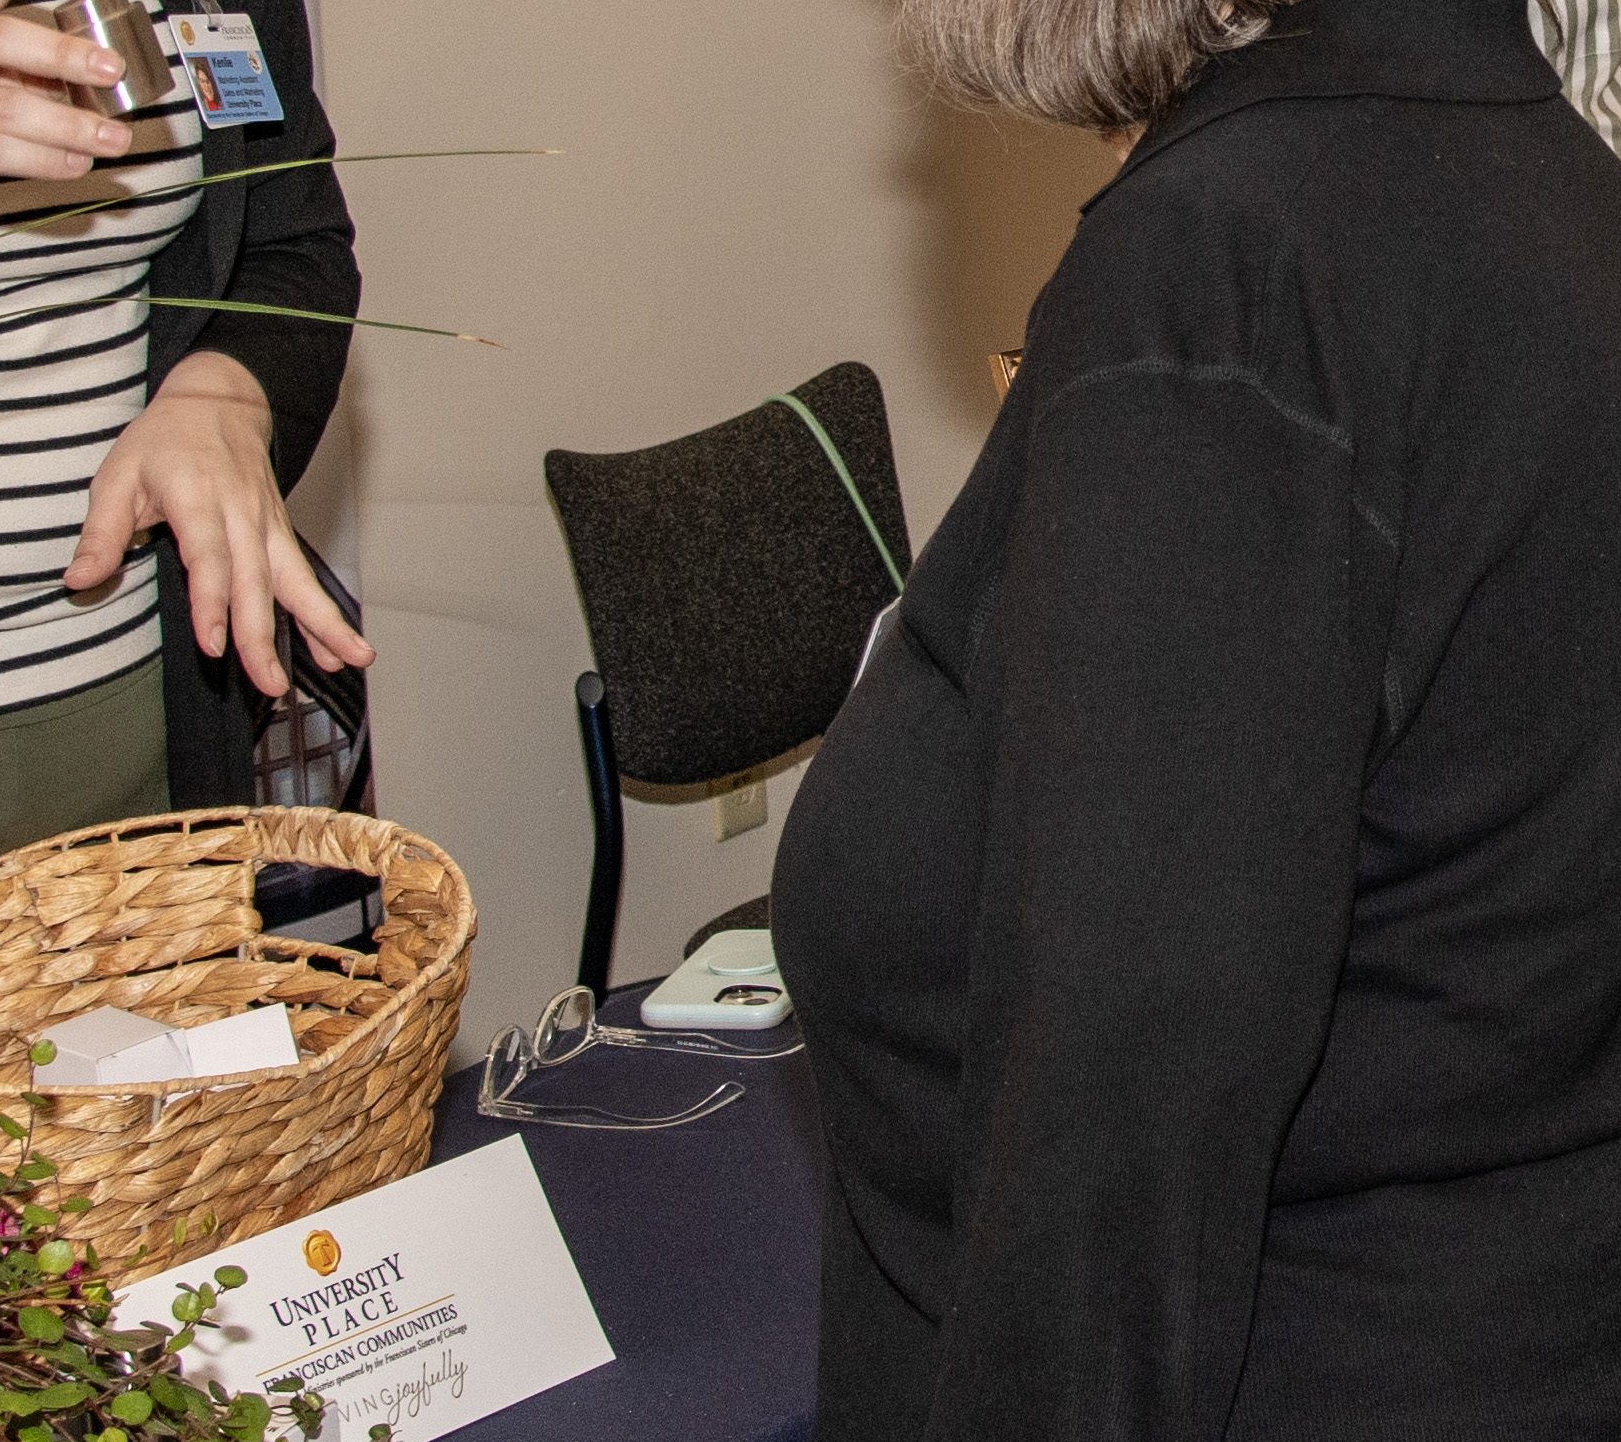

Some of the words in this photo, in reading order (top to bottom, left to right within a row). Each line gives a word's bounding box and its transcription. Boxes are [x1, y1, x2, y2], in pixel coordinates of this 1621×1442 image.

[268, 1252, 405, 1327] UNIVERSITY
[301, 1290, 399, 1347] PLACE
[336, 1363, 365, 1387] sponsored
[365, 1361, 374, 1374] by
[374, 1357, 385, 1368] the
[385, 1345, 417, 1365] Franciscan
[417, 1336, 436, 1351] Sisters
[437, 1329, 444, 1344] of
[443, 1323, 468, 1339] Chicago
[356, 1303, 458, 1357] COMMUNITIES
